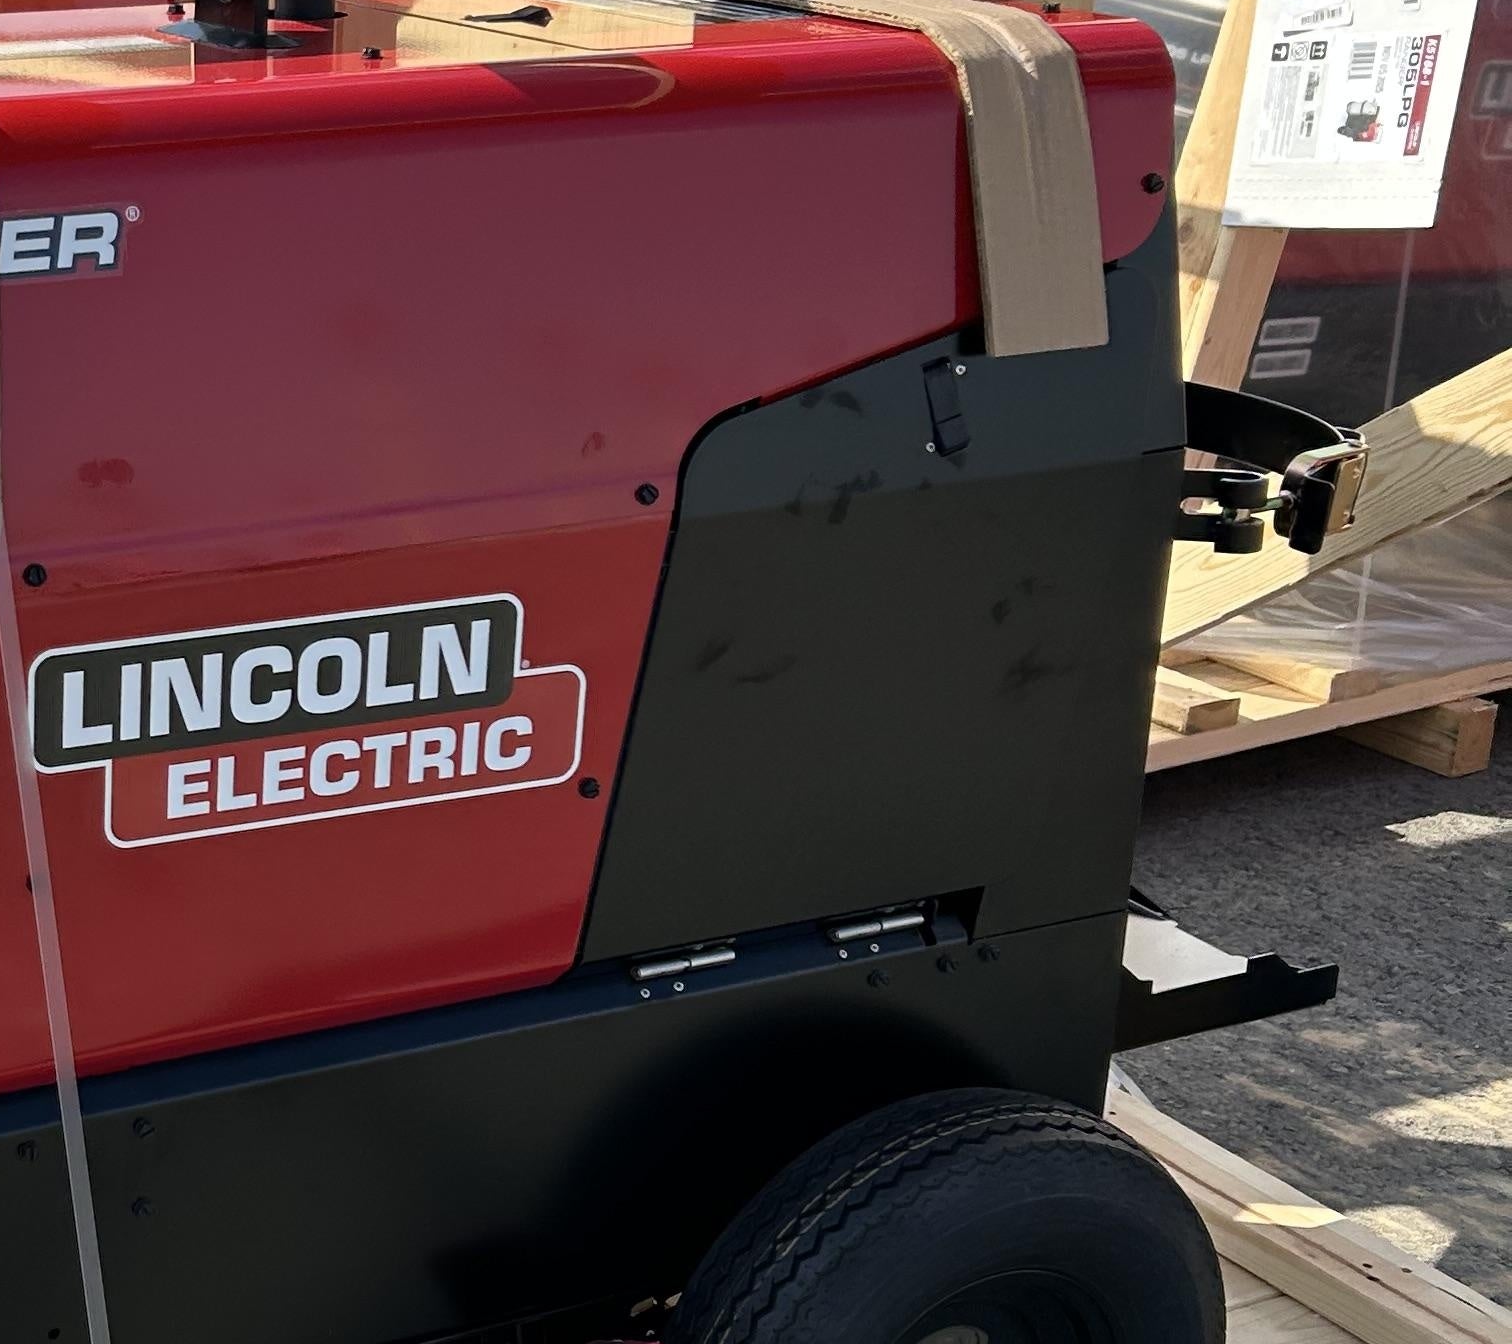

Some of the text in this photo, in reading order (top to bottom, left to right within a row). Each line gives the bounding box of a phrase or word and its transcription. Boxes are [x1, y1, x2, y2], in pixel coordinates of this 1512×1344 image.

[1396, 36, 1423, 128] 305LPG
[62, 619, 491, 749] LINCOLN
[166, 715, 533, 819] ELECTRIC
